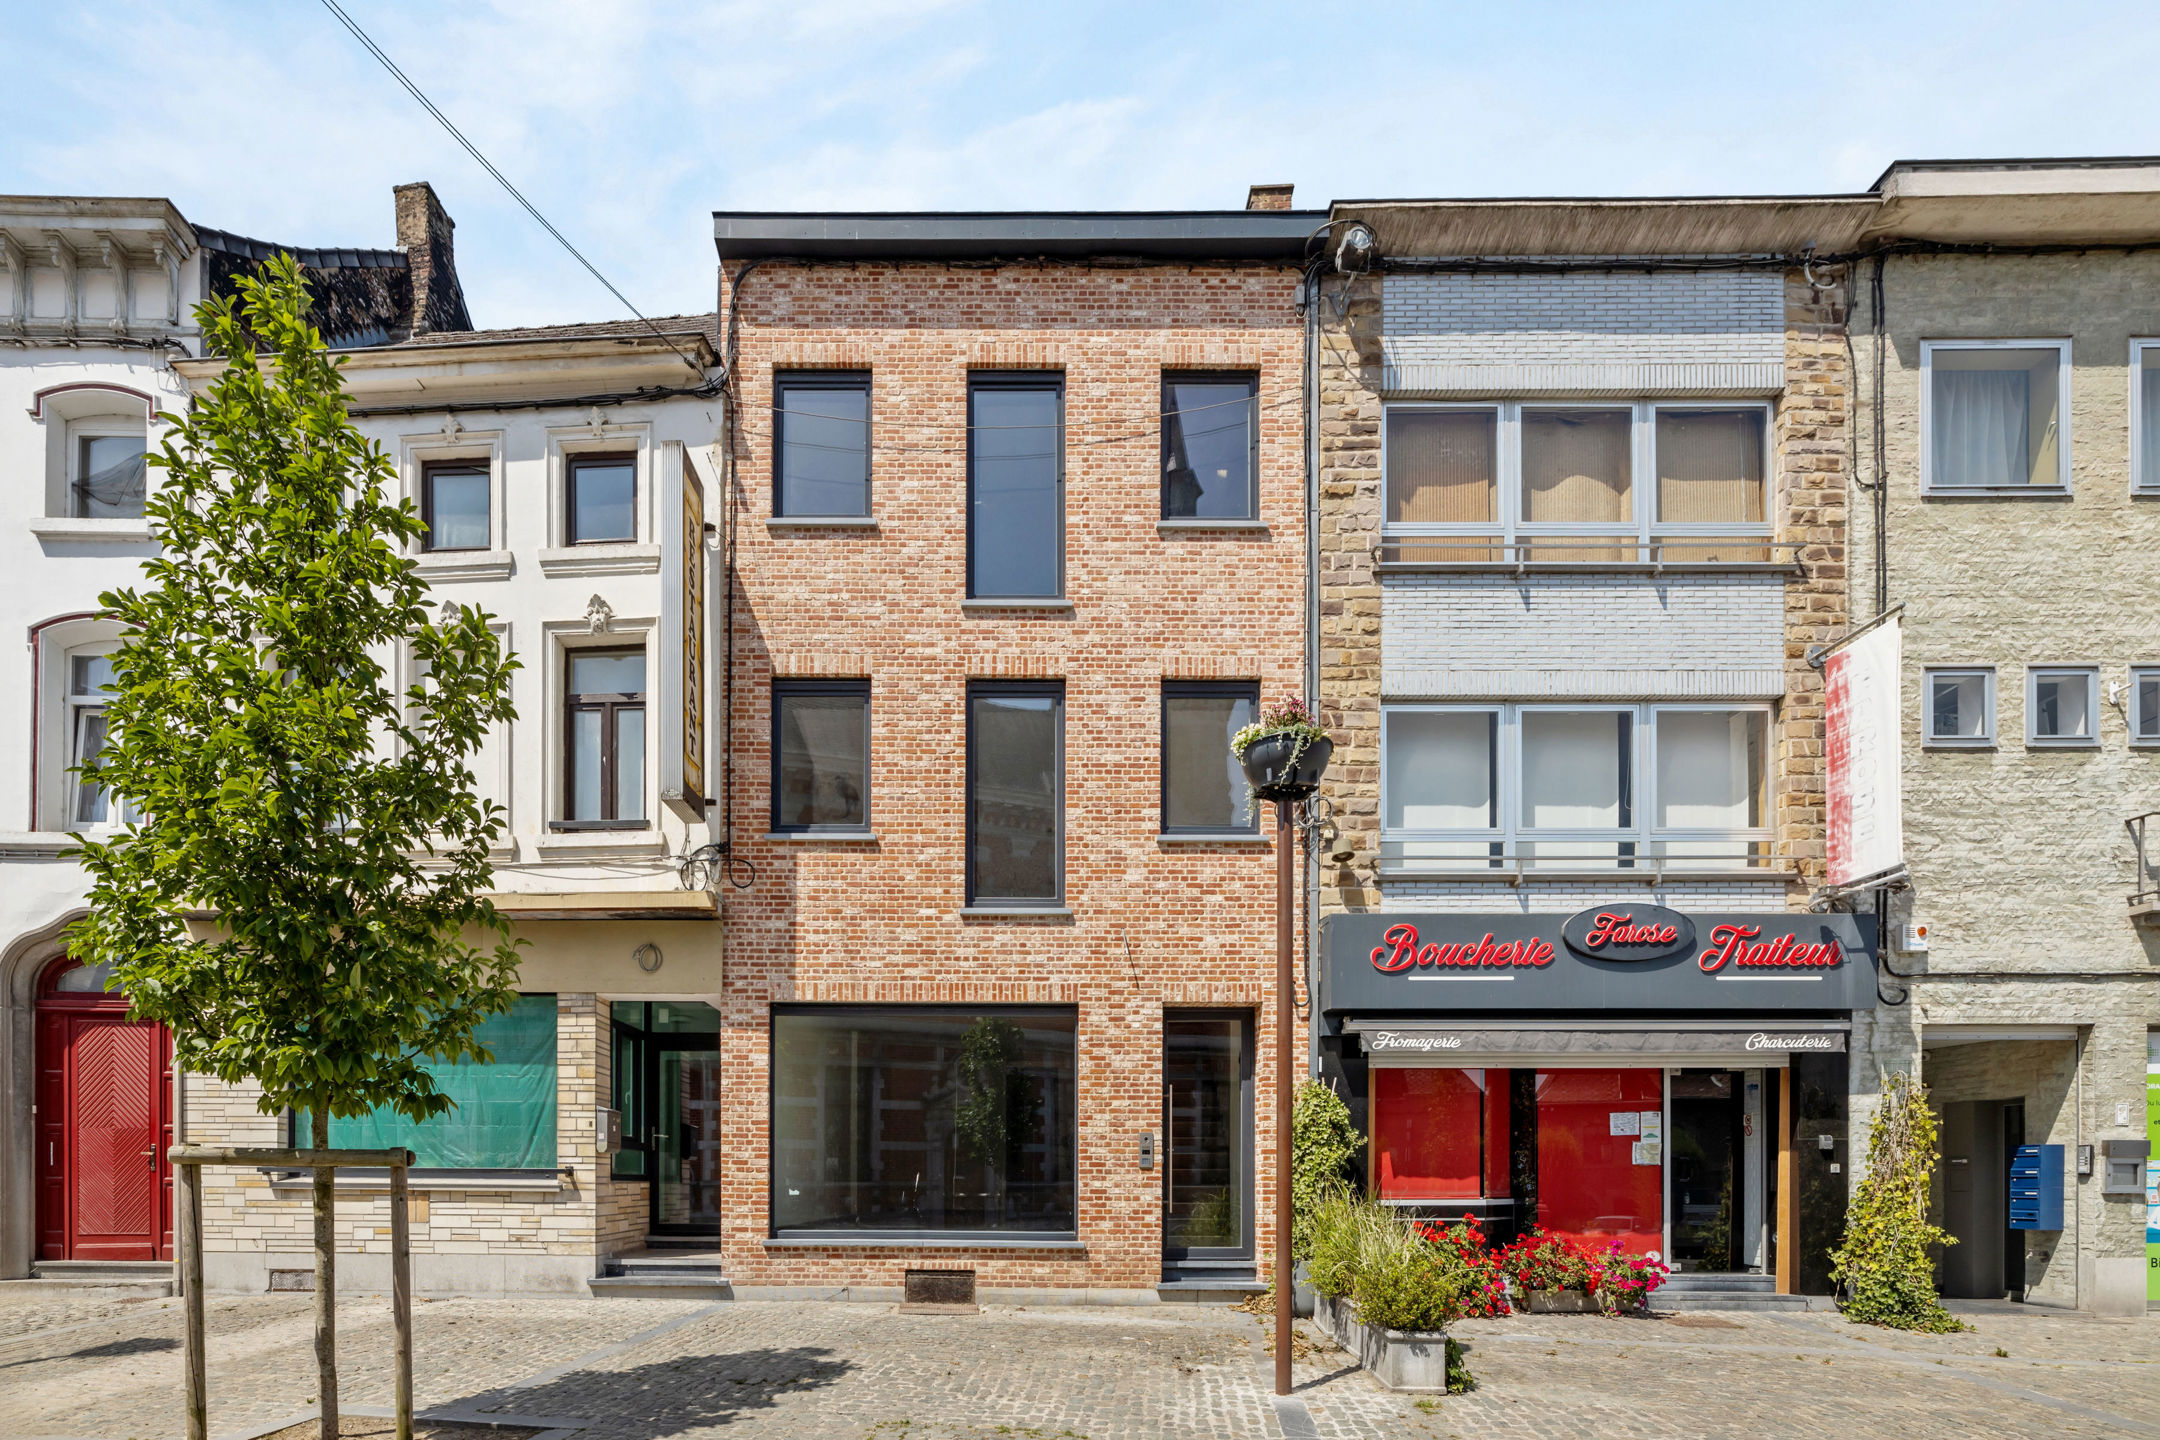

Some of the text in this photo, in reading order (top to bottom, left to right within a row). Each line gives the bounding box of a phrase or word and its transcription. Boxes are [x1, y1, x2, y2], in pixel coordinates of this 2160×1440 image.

[688, 516, 697, 757] RESTAURANT
[1370, 923, 1556, 972] Boucherie
[1586, 912, 1677, 947] Farose
[1698, 924, 1843, 972] Traiteur
[1372, 1031, 1462, 1051] Fromagerie
[1745, 1032, 1832, 1051] Charcuterie
